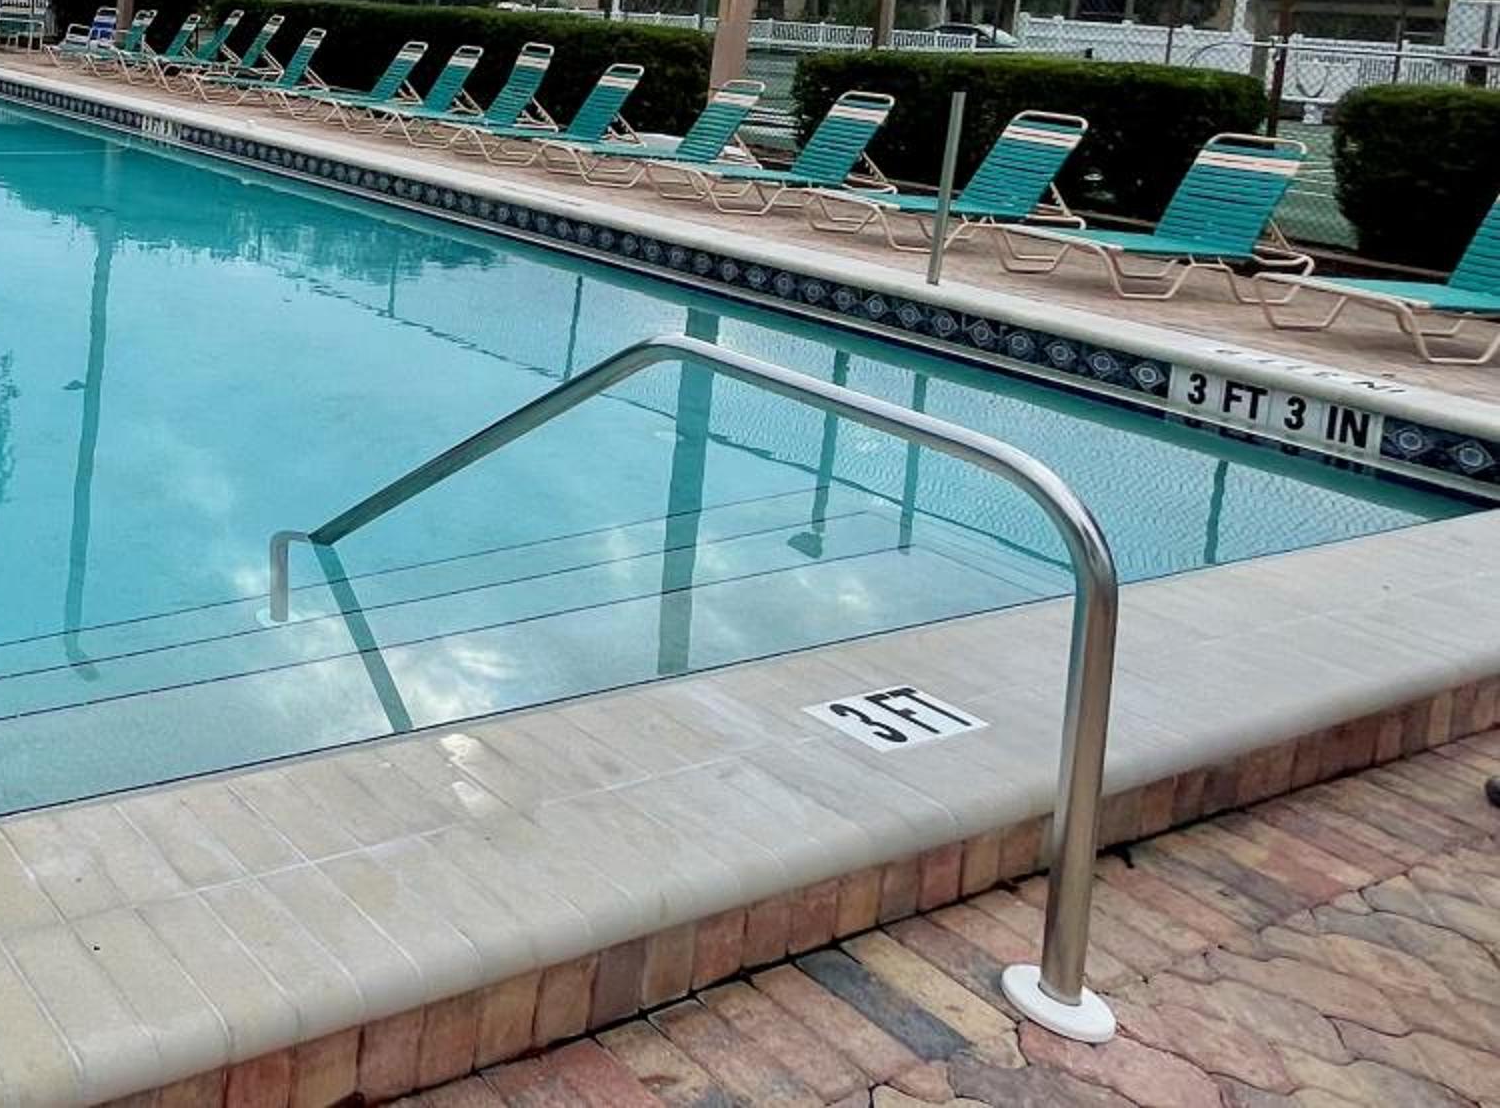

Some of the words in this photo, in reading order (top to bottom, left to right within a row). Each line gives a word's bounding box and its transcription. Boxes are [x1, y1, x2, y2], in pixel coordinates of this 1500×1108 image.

[1187, 373, 1207, 405] 3
[1222, 380, 1269, 419] FT
[1283, 398, 1307, 431] 3
[1326, 405, 1370, 449] IN
[829, 703, 909, 743] 3
[864, 686, 972, 735] FT
